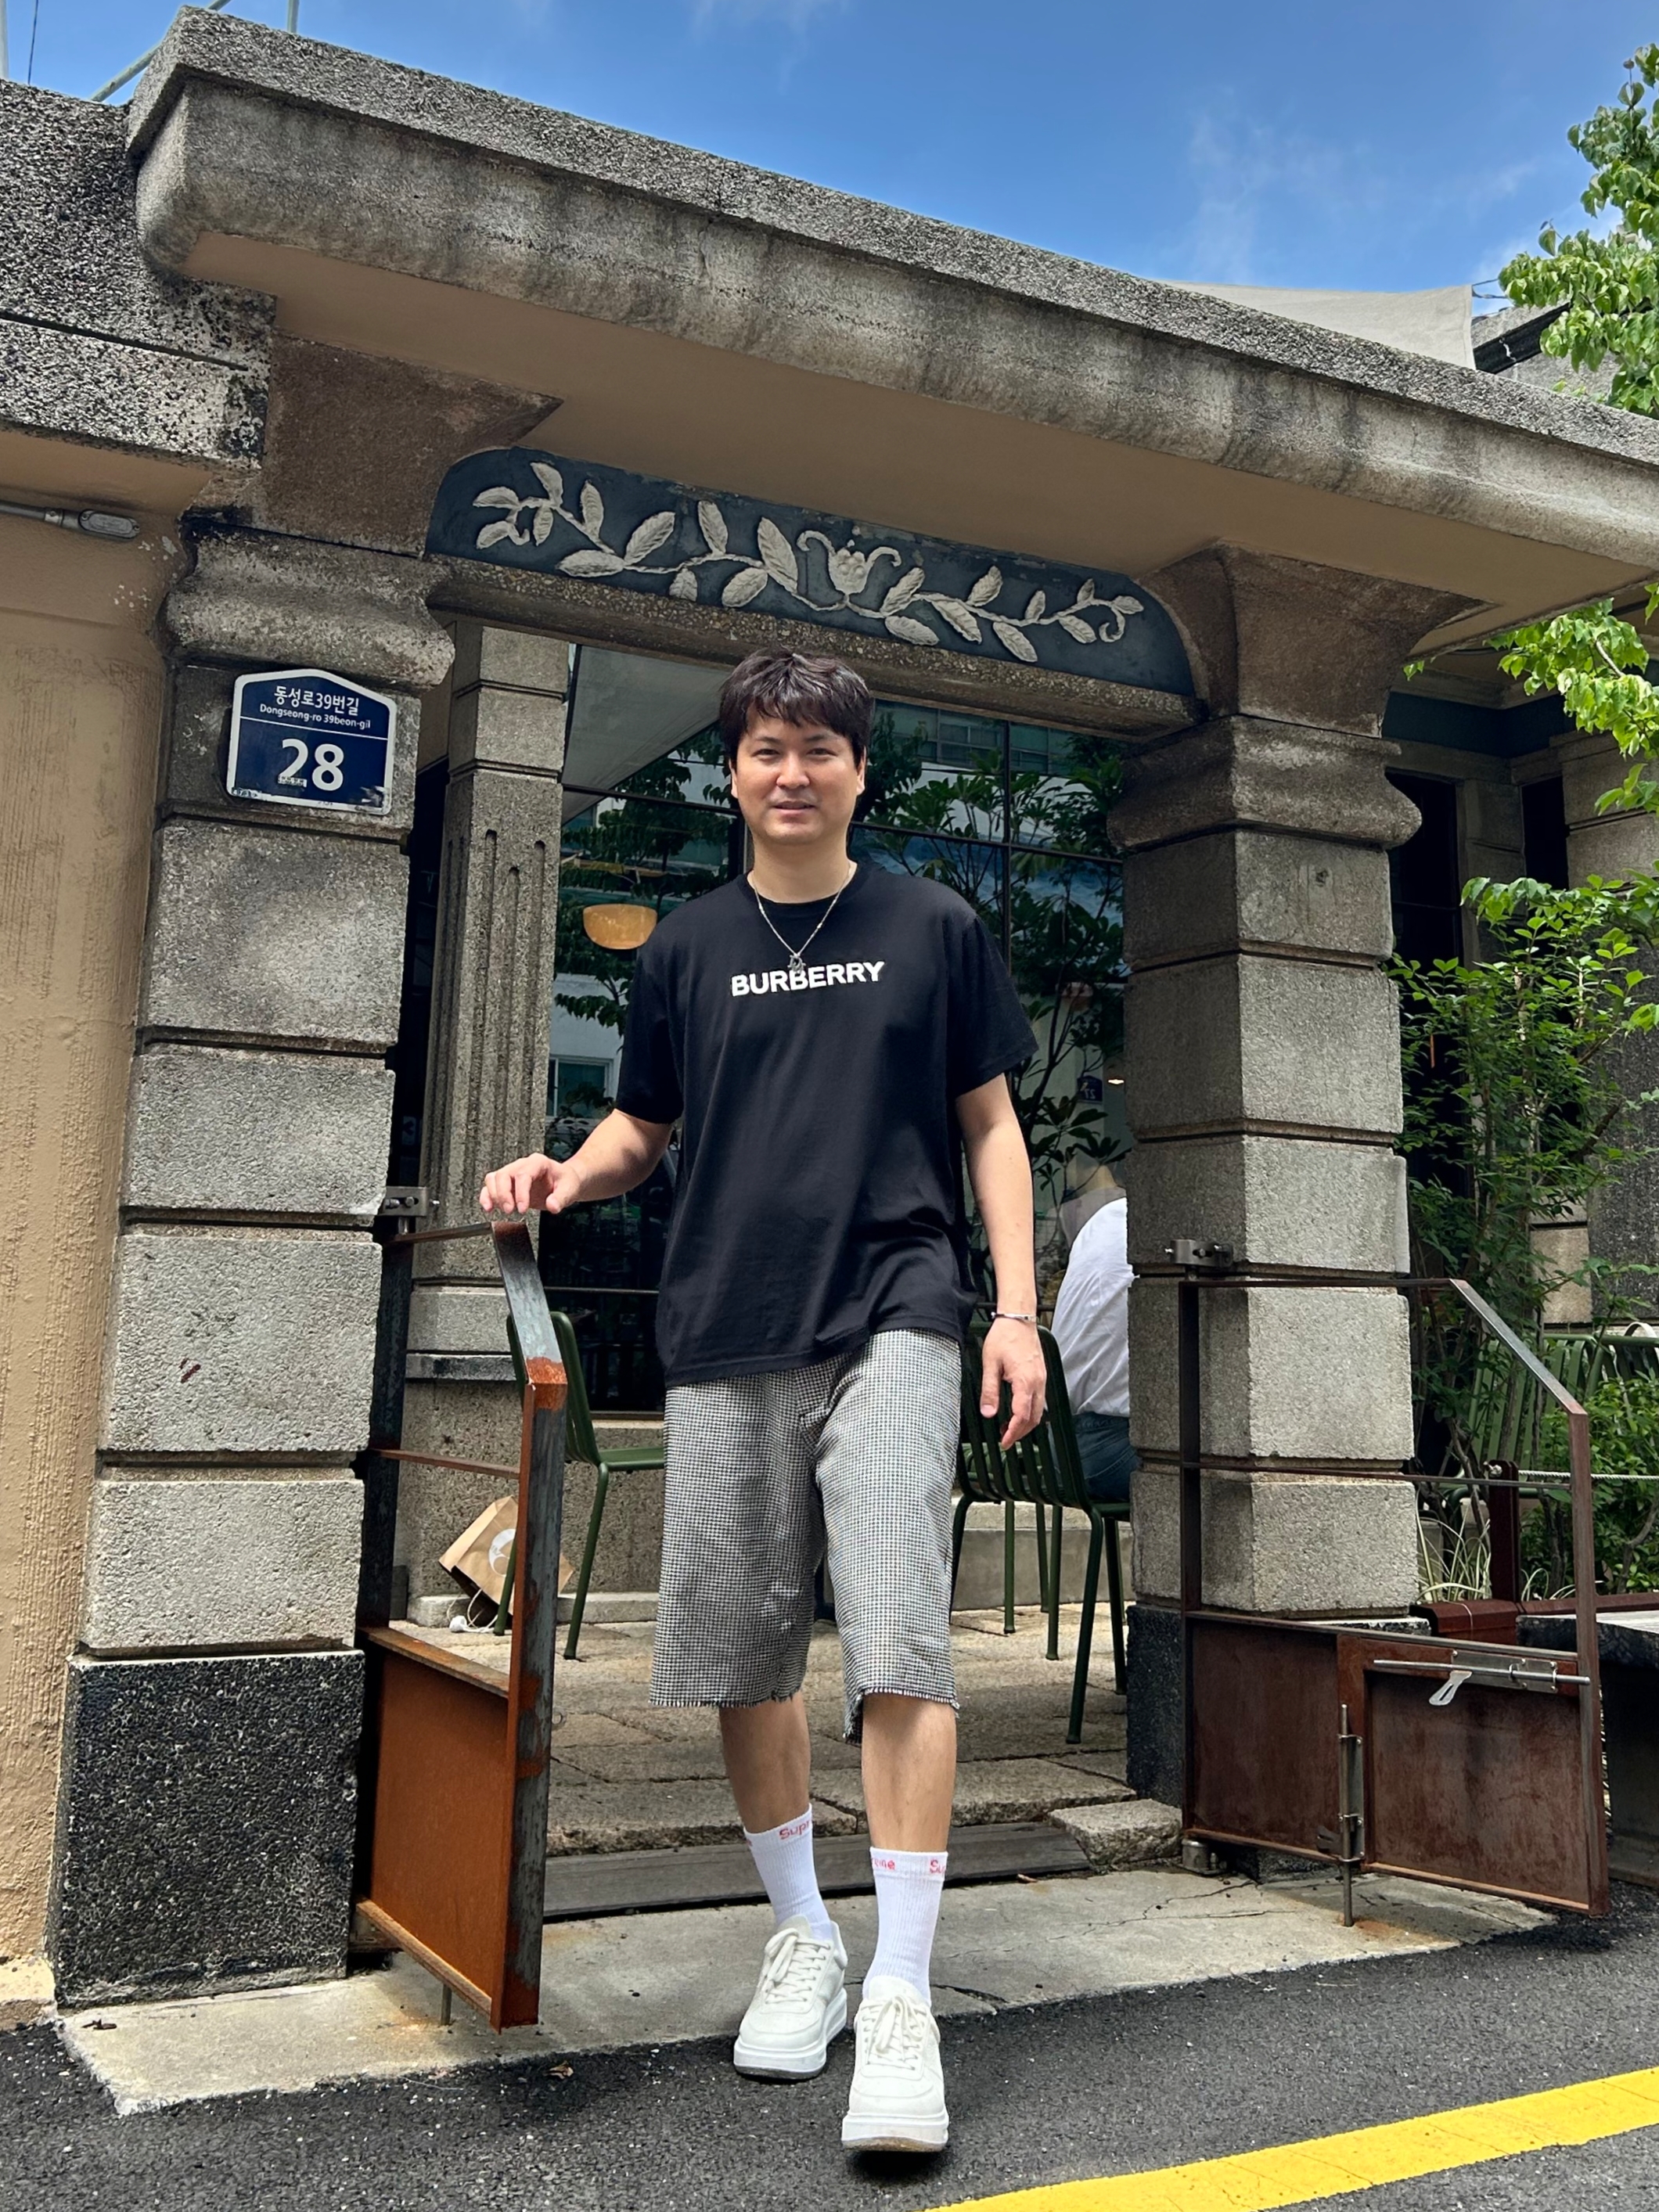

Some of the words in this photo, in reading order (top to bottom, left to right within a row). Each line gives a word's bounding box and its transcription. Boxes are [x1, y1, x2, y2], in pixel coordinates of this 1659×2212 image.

[260, 703, 322, 721] Dongseong-ro
[323, 714, 371, 729] 39beon-gil
[274, 685, 359, 716] 동성로39번길
[278, 739, 344, 791] 28
[731, 961, 885, 996] BURBERRY
